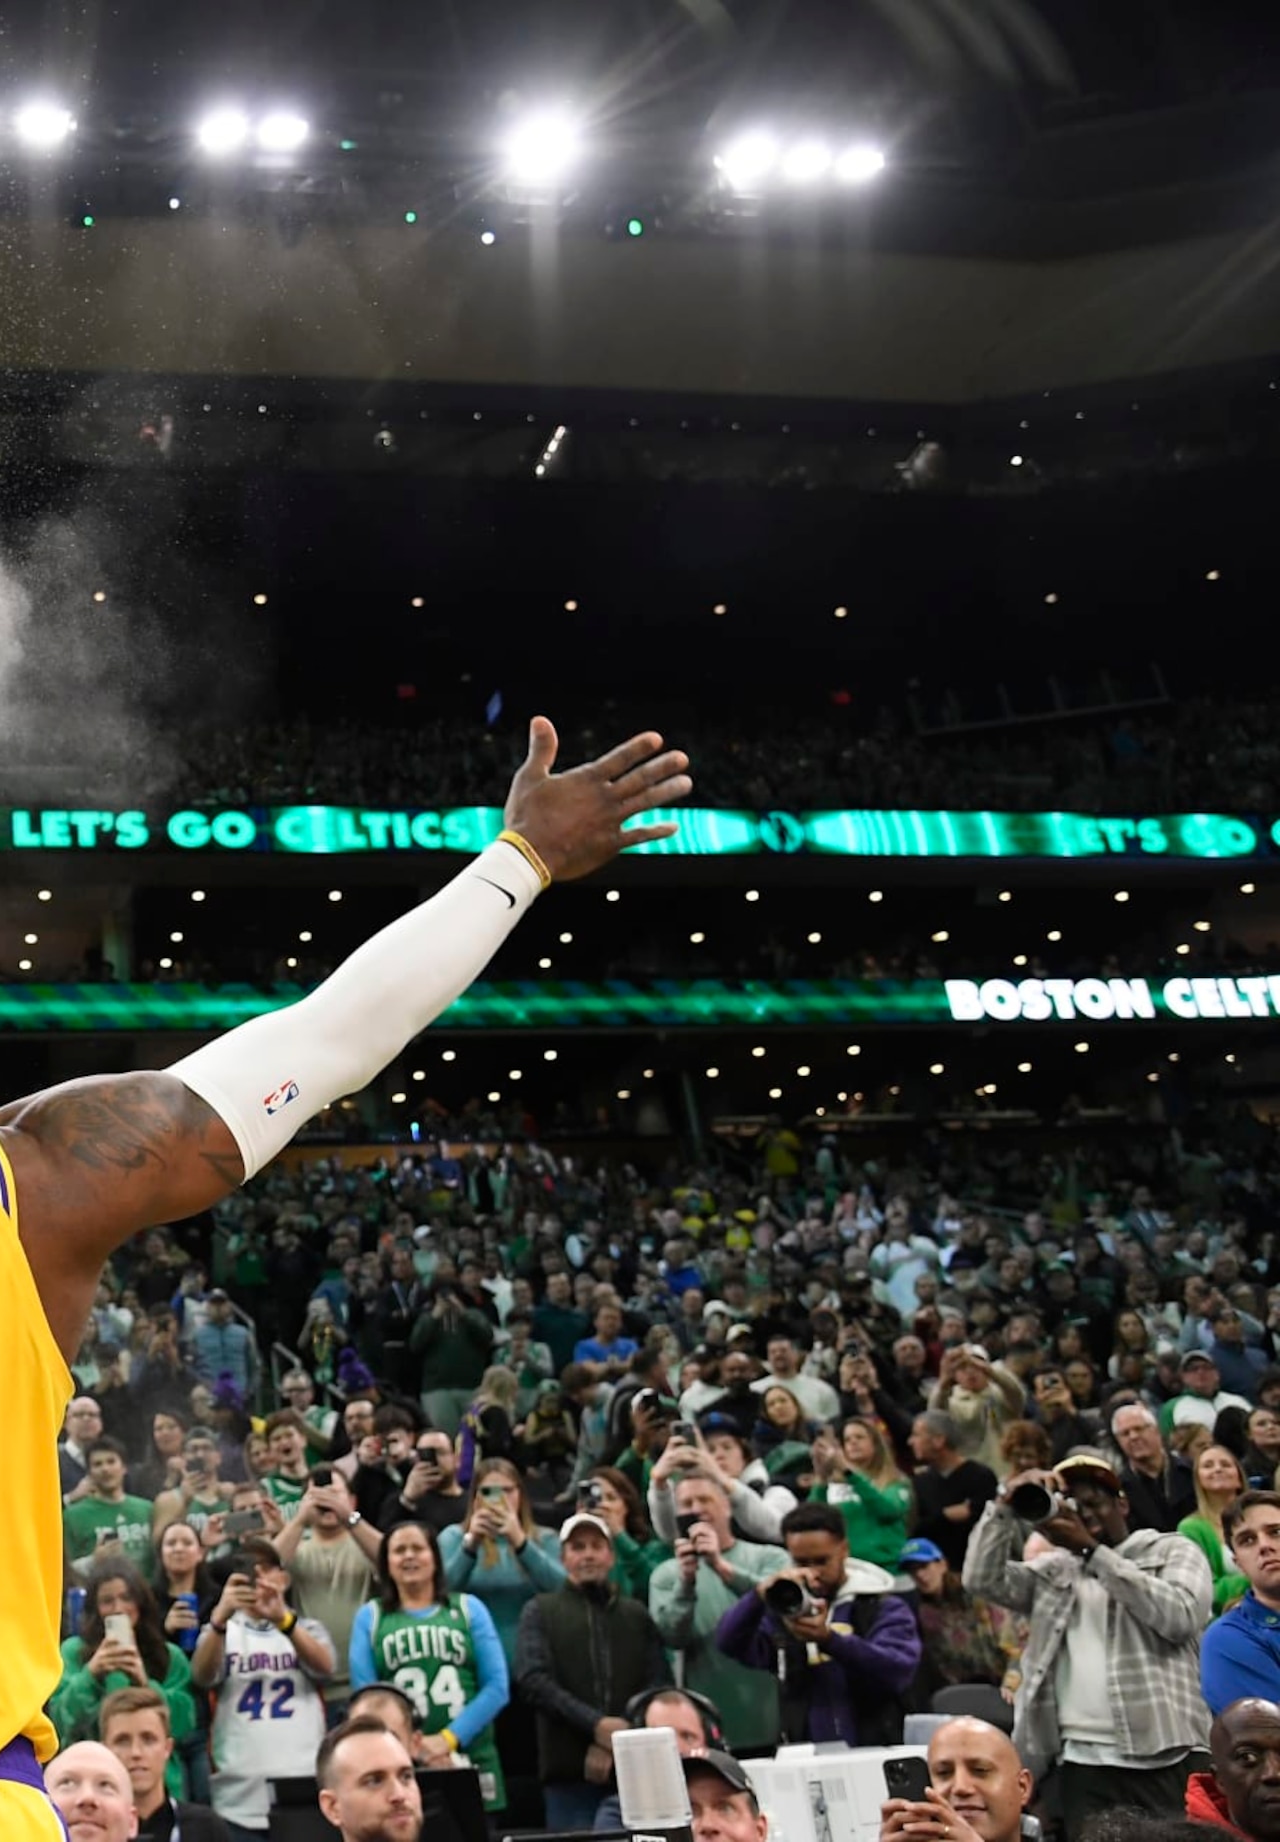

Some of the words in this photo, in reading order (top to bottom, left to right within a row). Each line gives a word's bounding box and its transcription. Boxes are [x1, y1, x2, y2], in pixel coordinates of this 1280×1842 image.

[12, 811, 149, 847] LET'S
[167, 811, 257, 848] GO
[944, 978, 1156, 1020] BOSTON
[382, 1624, 467, 1670] CELTICS
[237, 1677, 295, 1721] 42
